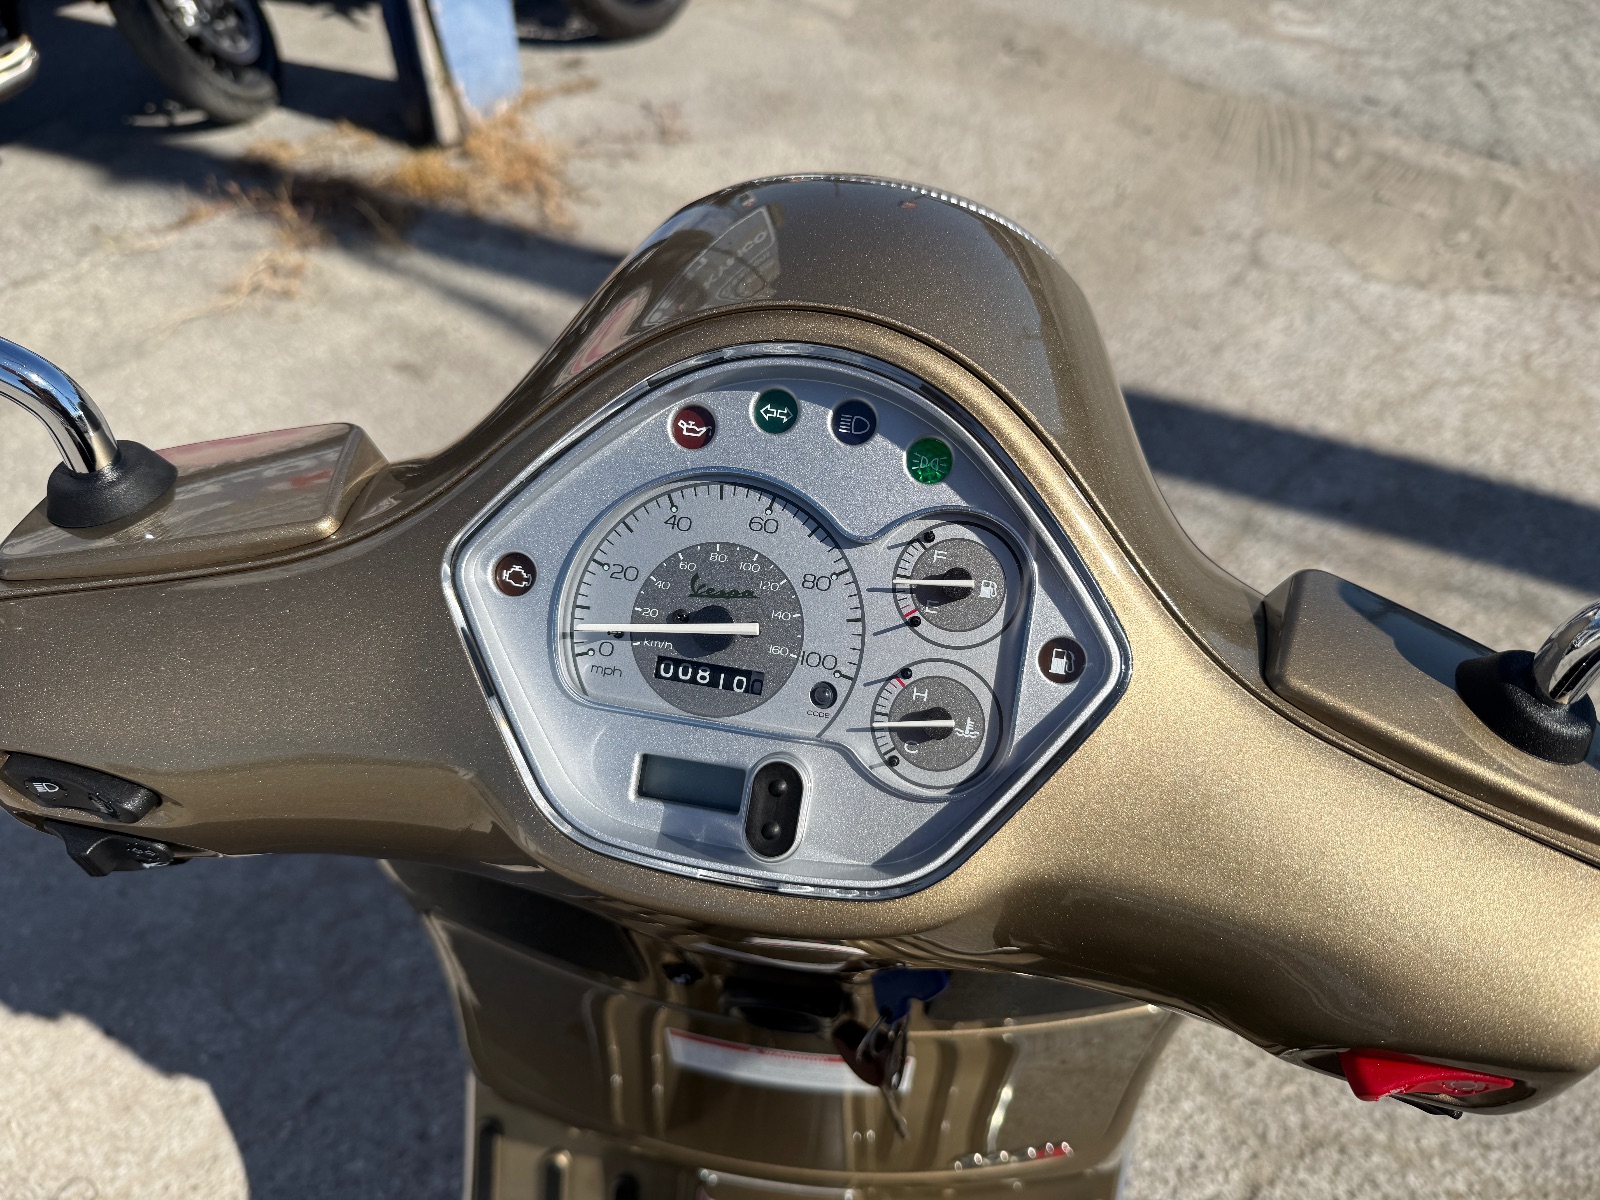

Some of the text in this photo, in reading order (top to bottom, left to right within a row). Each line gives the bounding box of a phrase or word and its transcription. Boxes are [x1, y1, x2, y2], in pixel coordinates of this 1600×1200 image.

[664, 514, 692, 532] 40
[748, 516, 779, 534] 60
[709, 552, 728, 563] 80
[932, 550, 947, 563] F
[609, 563, 639, 582] 20
[678, 562, 697, 572] 60
[739, 561, 761, 573] 100
[654, 580, 671, 590] 40
[688, 572, 760, 599] Vespa
[759, 580, 780, 591] 120
[801, 573, 832, 592] 80
[641, 608, 659, 618] 20
[771, 611, 791, 621] 140
[598, 641, 615, 657] 0
[643, 639, 673, 650] km/h
[769, 645, 789, 656] 160
[800, 651, 838, 671] 100
[590, 663, 623, 677] mph
[912, 687, 928, 701] H
[806, 709, 830, 719] CODE
[904, 740, 919, 753] C
